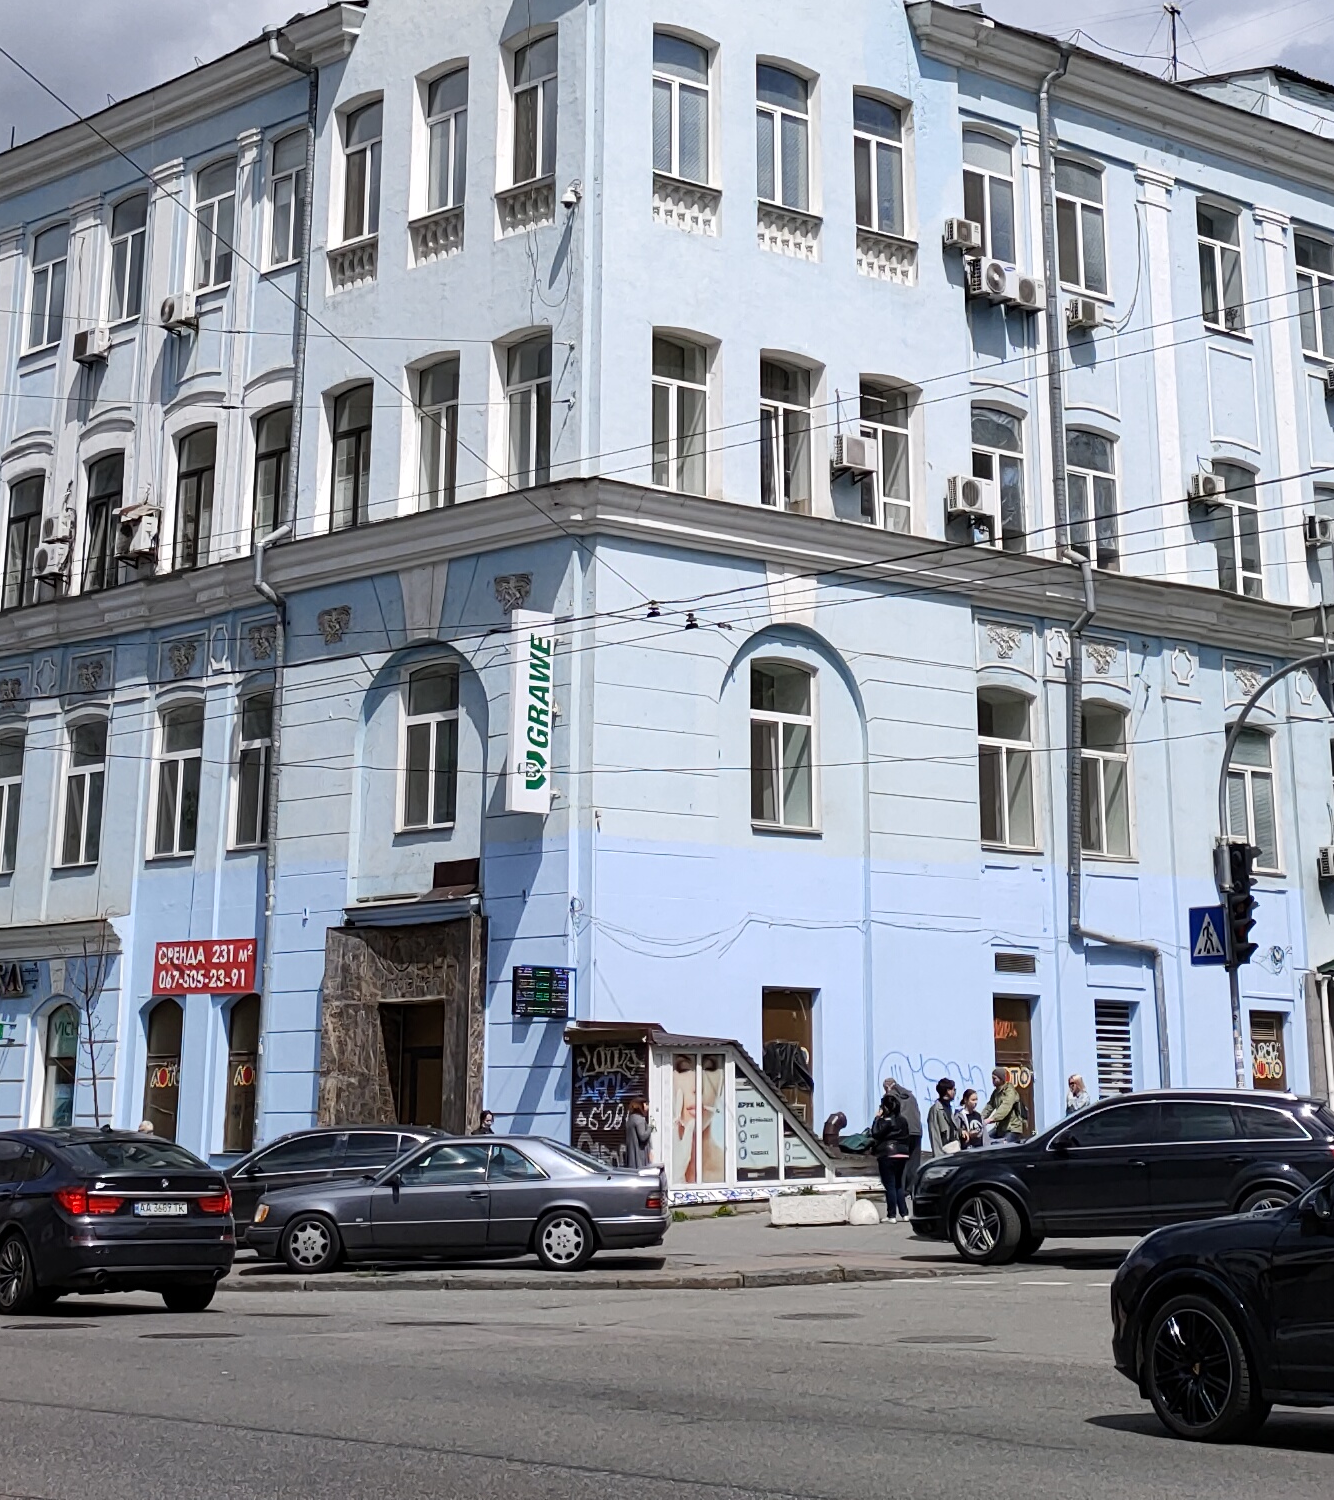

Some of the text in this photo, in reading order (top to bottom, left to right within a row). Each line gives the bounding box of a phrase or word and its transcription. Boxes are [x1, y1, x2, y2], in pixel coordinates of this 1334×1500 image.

[526, 633, 551, 749] GRAWE
[158, 946, 205, 966] ОРЕНДА
[212, 945, 234, 963] 231
[158, 968, 245, 989] 067-505-23-91
